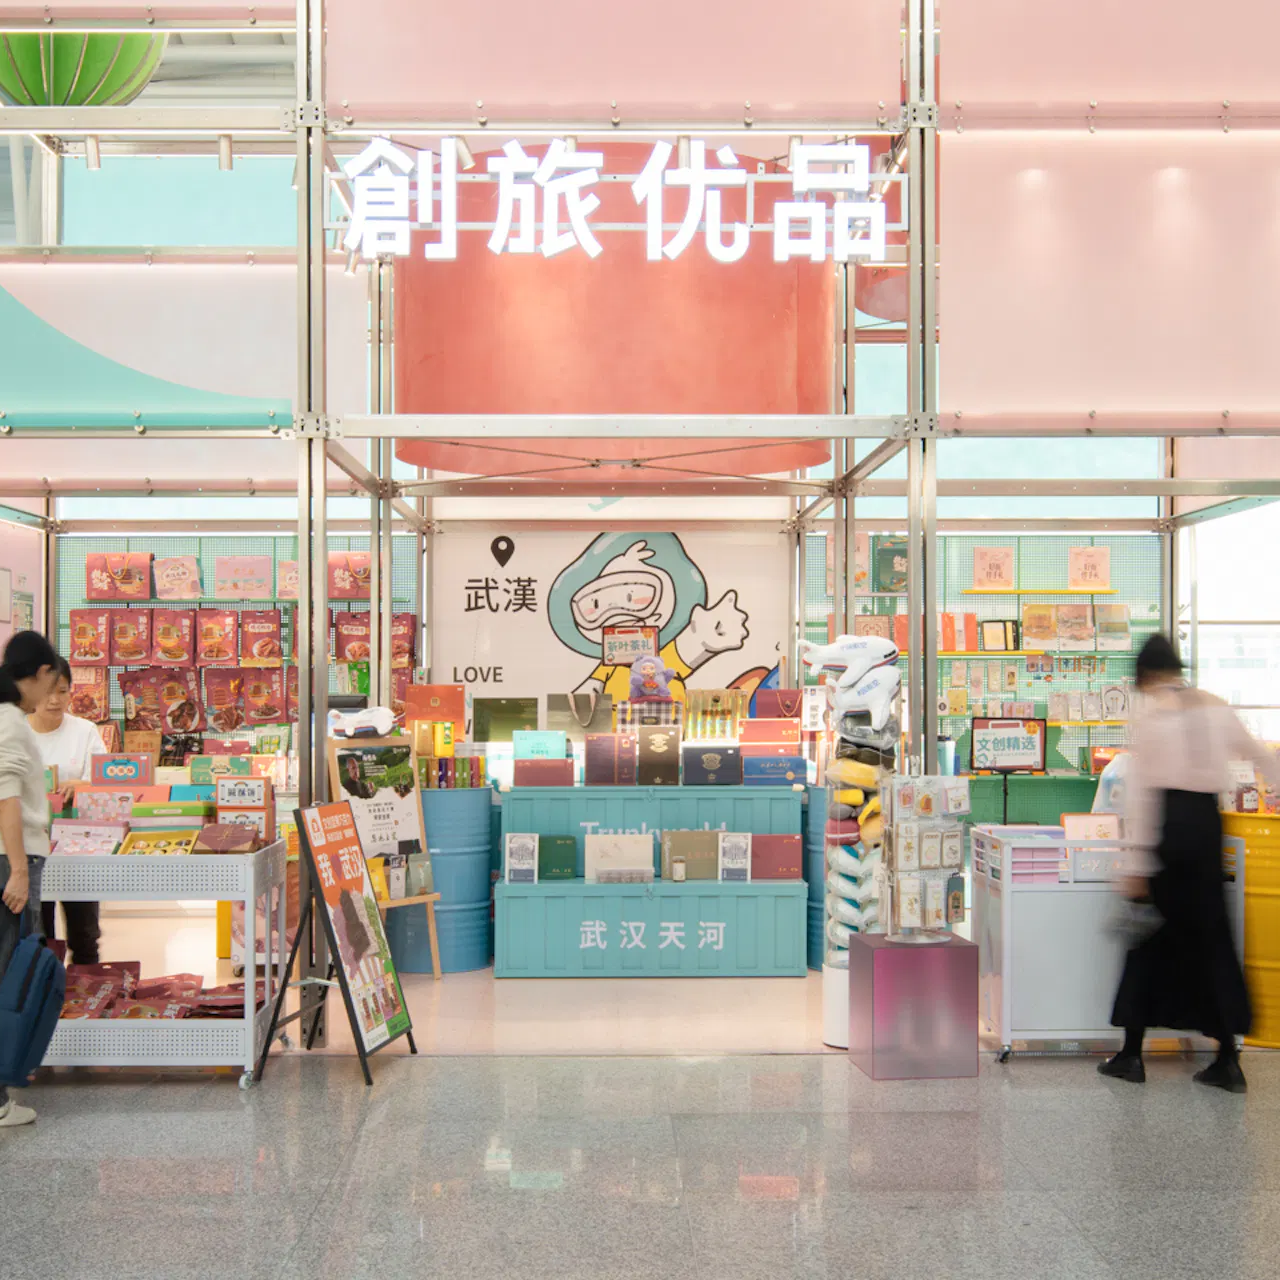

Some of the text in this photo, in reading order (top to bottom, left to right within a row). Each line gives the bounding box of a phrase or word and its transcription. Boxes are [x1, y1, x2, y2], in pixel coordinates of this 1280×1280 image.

[342, 136, 887, 264] 創旅优品
[464, 576, 538, 613] 武漢
[606, 638, 654, 653] 茶叶茶礼
[453, 666, 503, 684] LOVE
[975, 735, 1037, 752] 文创精选
[316, 845, 366, 888] 我 武汉
[579, 920, 726, 951] 武汉天河
